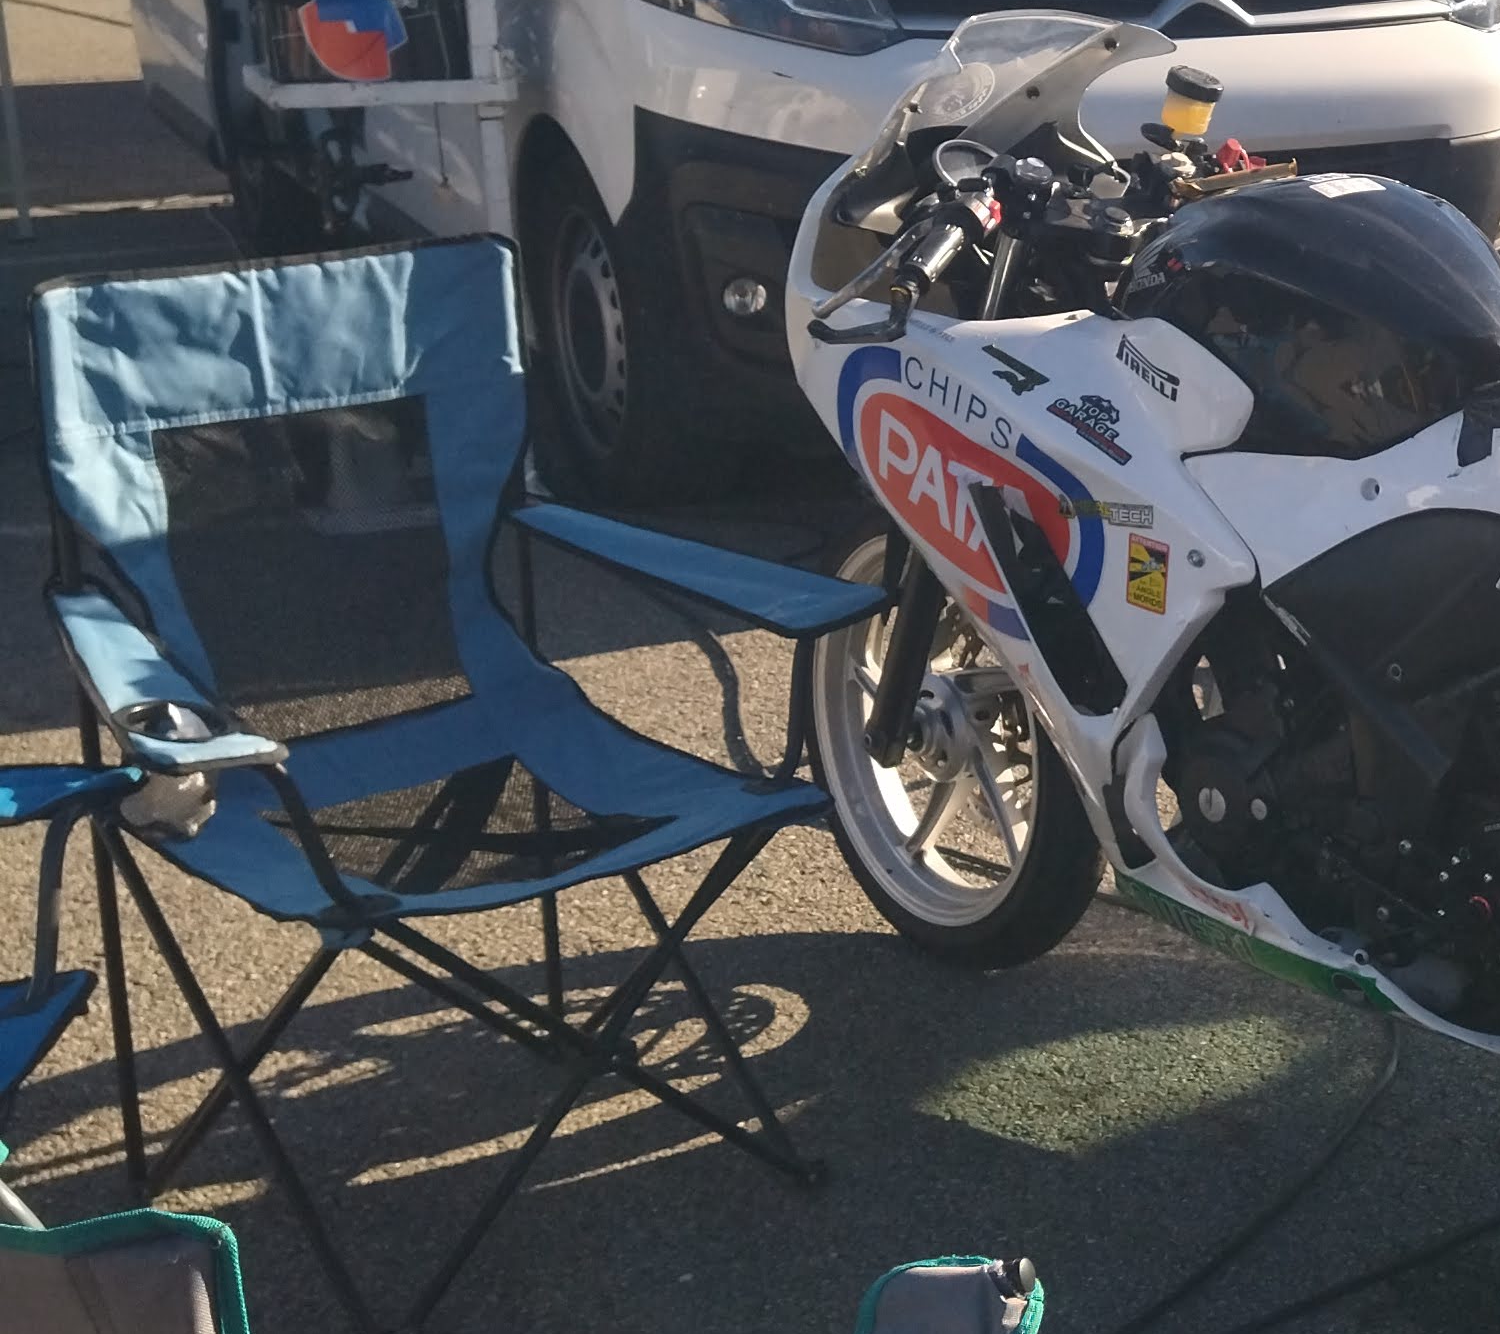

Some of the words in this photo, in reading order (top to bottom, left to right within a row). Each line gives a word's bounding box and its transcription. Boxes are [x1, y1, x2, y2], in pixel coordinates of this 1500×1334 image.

[1127, 271, 1166, 294] HONDA
[1115, 333, 1181, 403] PIRELLI
[904, 356, 1013, 450] CHIPS
[1055, 398, 1120, 442] GARAGE
[1081, 401, 1110, 422] TOP
